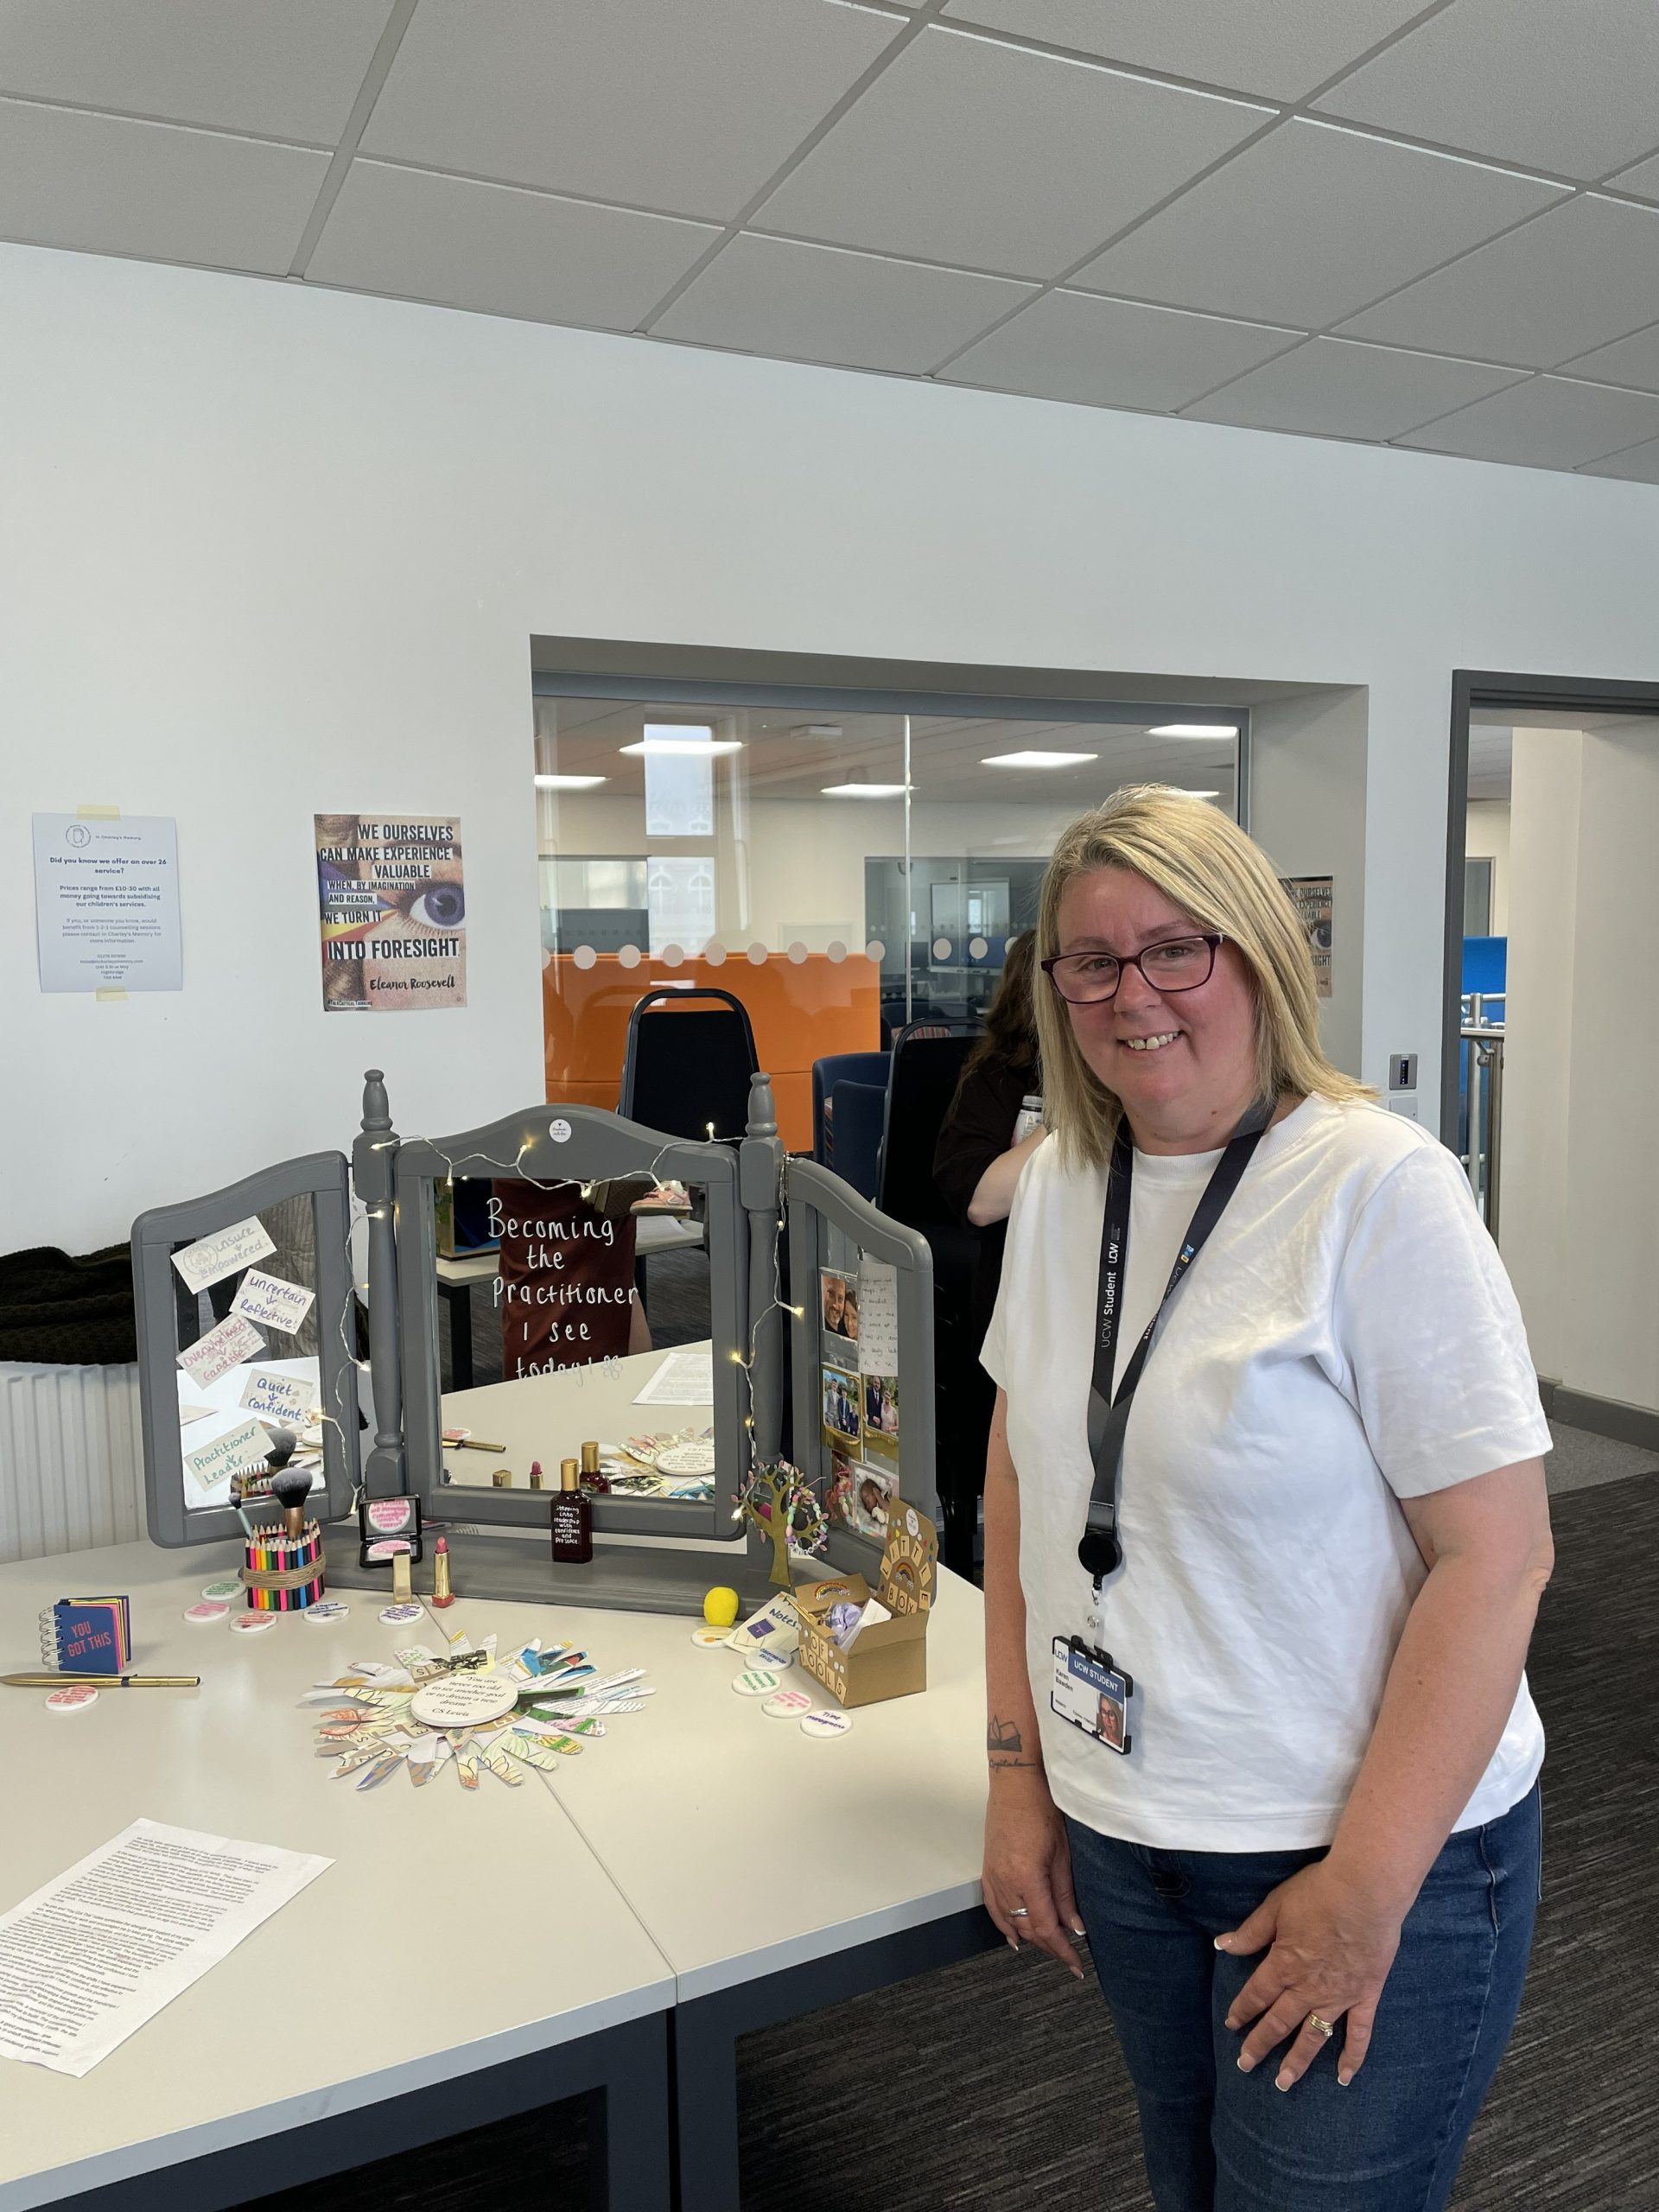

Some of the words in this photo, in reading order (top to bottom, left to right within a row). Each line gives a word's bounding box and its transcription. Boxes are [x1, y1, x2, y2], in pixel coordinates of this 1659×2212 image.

[358, 824, 378, 839] WE
[384, 825, 453, 841] OURSELVES
[321, 847, 342, 861] CAN
[347, 847, 379, 860] MAKE
[384, 847, 451, 860] EXPERIENCE
[375, 865, 429, 878] VALUABLE
[357, 881, 366, 890] BY
[369, 882, 414, 891] IMAGINATION
[329, 894, 344, 903] AND
[347, 895, 375, 904] REASON,
[325, 913, 339, 924] WE
[342, 912, 369, 924] TURN
[373, 911, 382, 922] IT
[328, 941, 366, 959] INTO
[370, 976, 409, 990] Eleanor
[486, 1197, 614, 1246] Becoming
[527, 1244, 565, 1269] the
[493, 1276, 639, 1308] Practitioner
[1104, 1271, 1116, 1315] Student
[524, 1322, 528, 1341] I
[549, 1322, 591, 1342] see
[1101, 1319, 1112, 1348] UCW
[257, 1378, 293, 1396] Quiet
[193, 1426, 256, 1471] Practitioner
[204, 1456, 243, 1485] Leader
[888, 1589, 913, 1615] BOX
[71, 1621, 91, 1638] YOU
[68, 1640, 86, 1657] GOT
[88, 1632, 111, 1650] THIS
[812, 1637, 825, 1654] OF
[801, 1649, 843, 1695] TOOLS
[1074, 1660, 1089, 1674] UCW
[1089, 1669, 1118, 1692] STUDENT
[823, 1711, 841, 1719] Time
